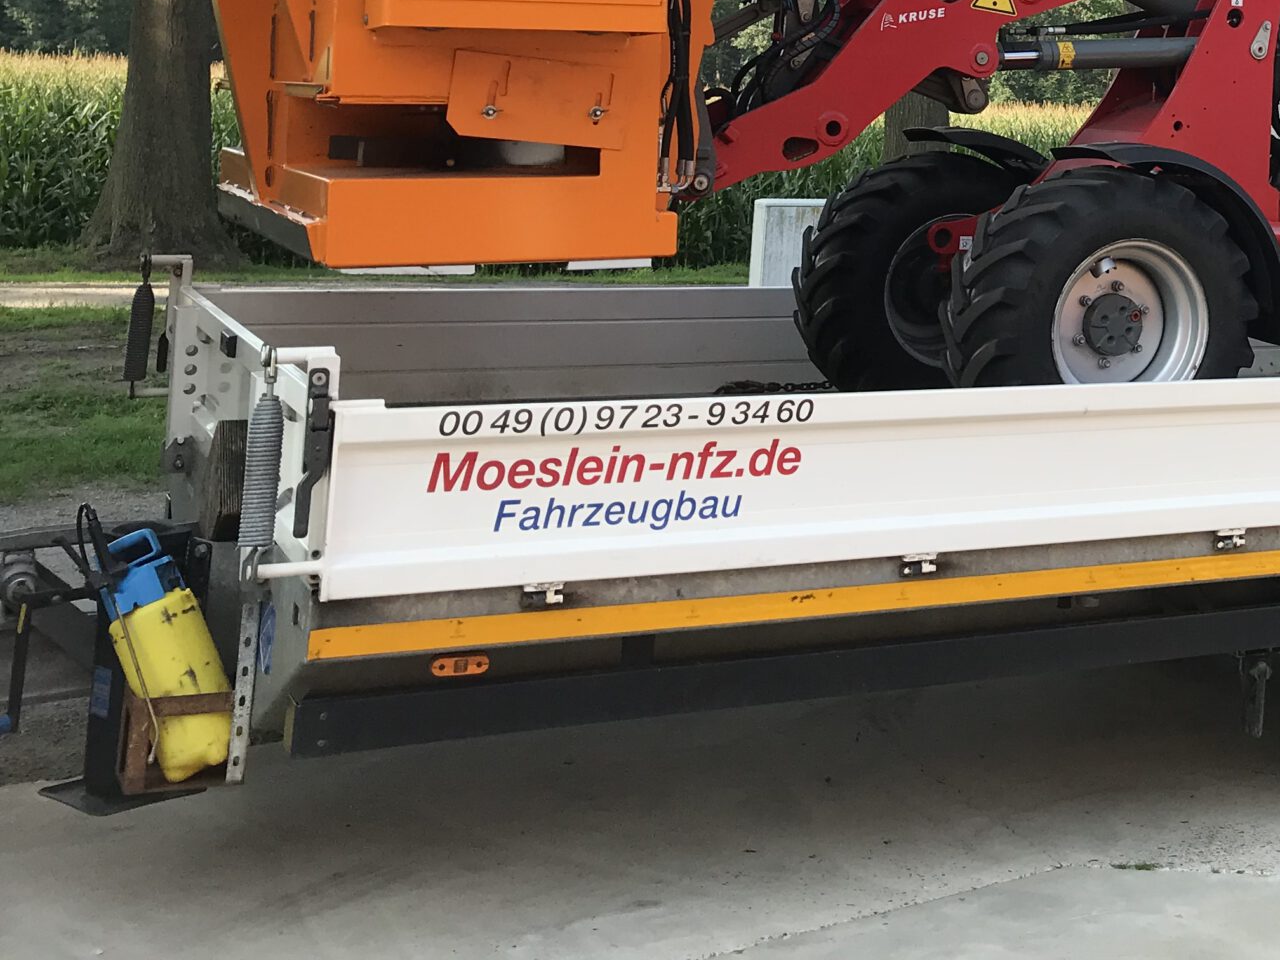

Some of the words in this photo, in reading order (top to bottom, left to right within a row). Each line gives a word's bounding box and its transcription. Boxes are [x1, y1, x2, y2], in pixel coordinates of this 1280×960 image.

[898, 7, 946, 24] KRUSE
[427, 439, 802, 493] Moeslein-nfz.de
[494, 490, 743, 532] Fahrzeugbau
